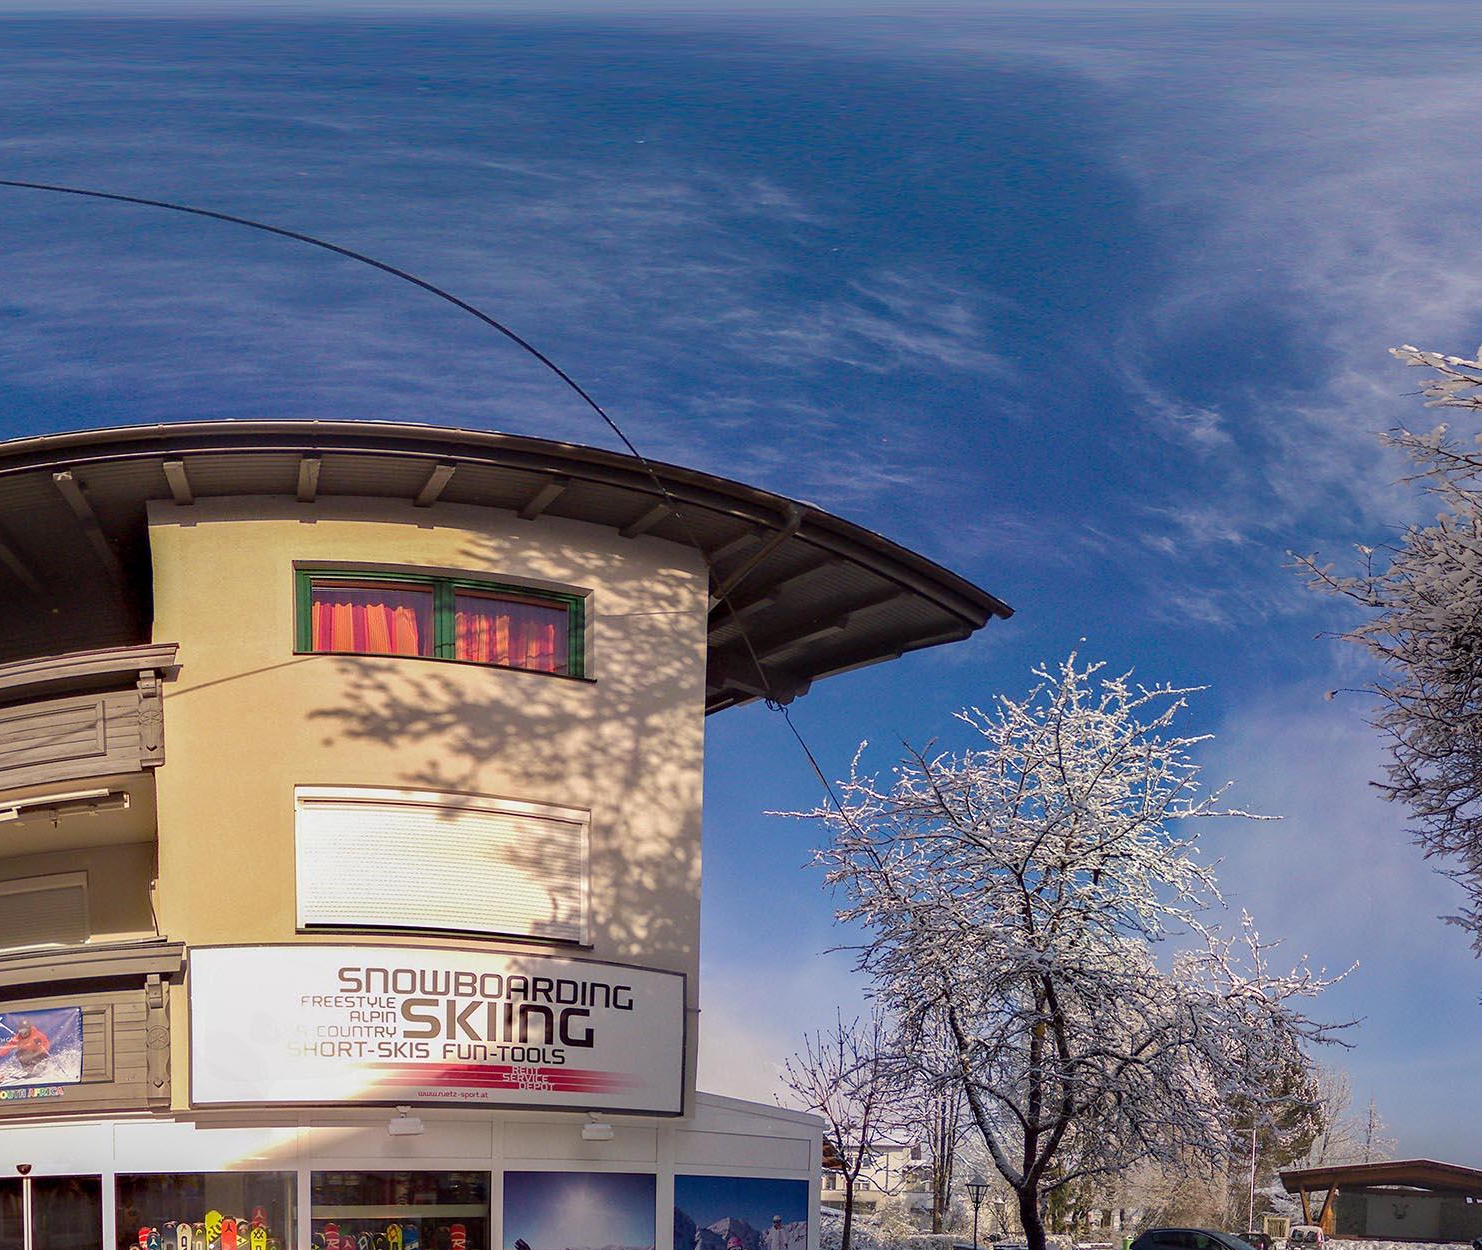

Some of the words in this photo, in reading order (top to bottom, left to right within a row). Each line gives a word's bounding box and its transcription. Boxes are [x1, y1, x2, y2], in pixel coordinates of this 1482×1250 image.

[338, 967, 633, 1011] SNOWBOARDING
[301, 995, 396, 1010] FREESTYLE
[350, 1011, 396, 1023] ALPIN
[400, 998, 594, 1048] SKIING
[316, 1025, 396, 1039] COUNTRY
[289, 1040, 430, 1059] SHORT-SKIS
[442, 1043, 565, 1065] FUN-TOOLS
[512, 1065, 540, 1075] RENT
[502, 1073, 549, 1084] SERVICE
[27, 1087, 64, 1098] AFRICA
[519, 1082, 555, 1092] DEPOT
[418, 1089, 488, 1099] www.ruetz-sport.at
